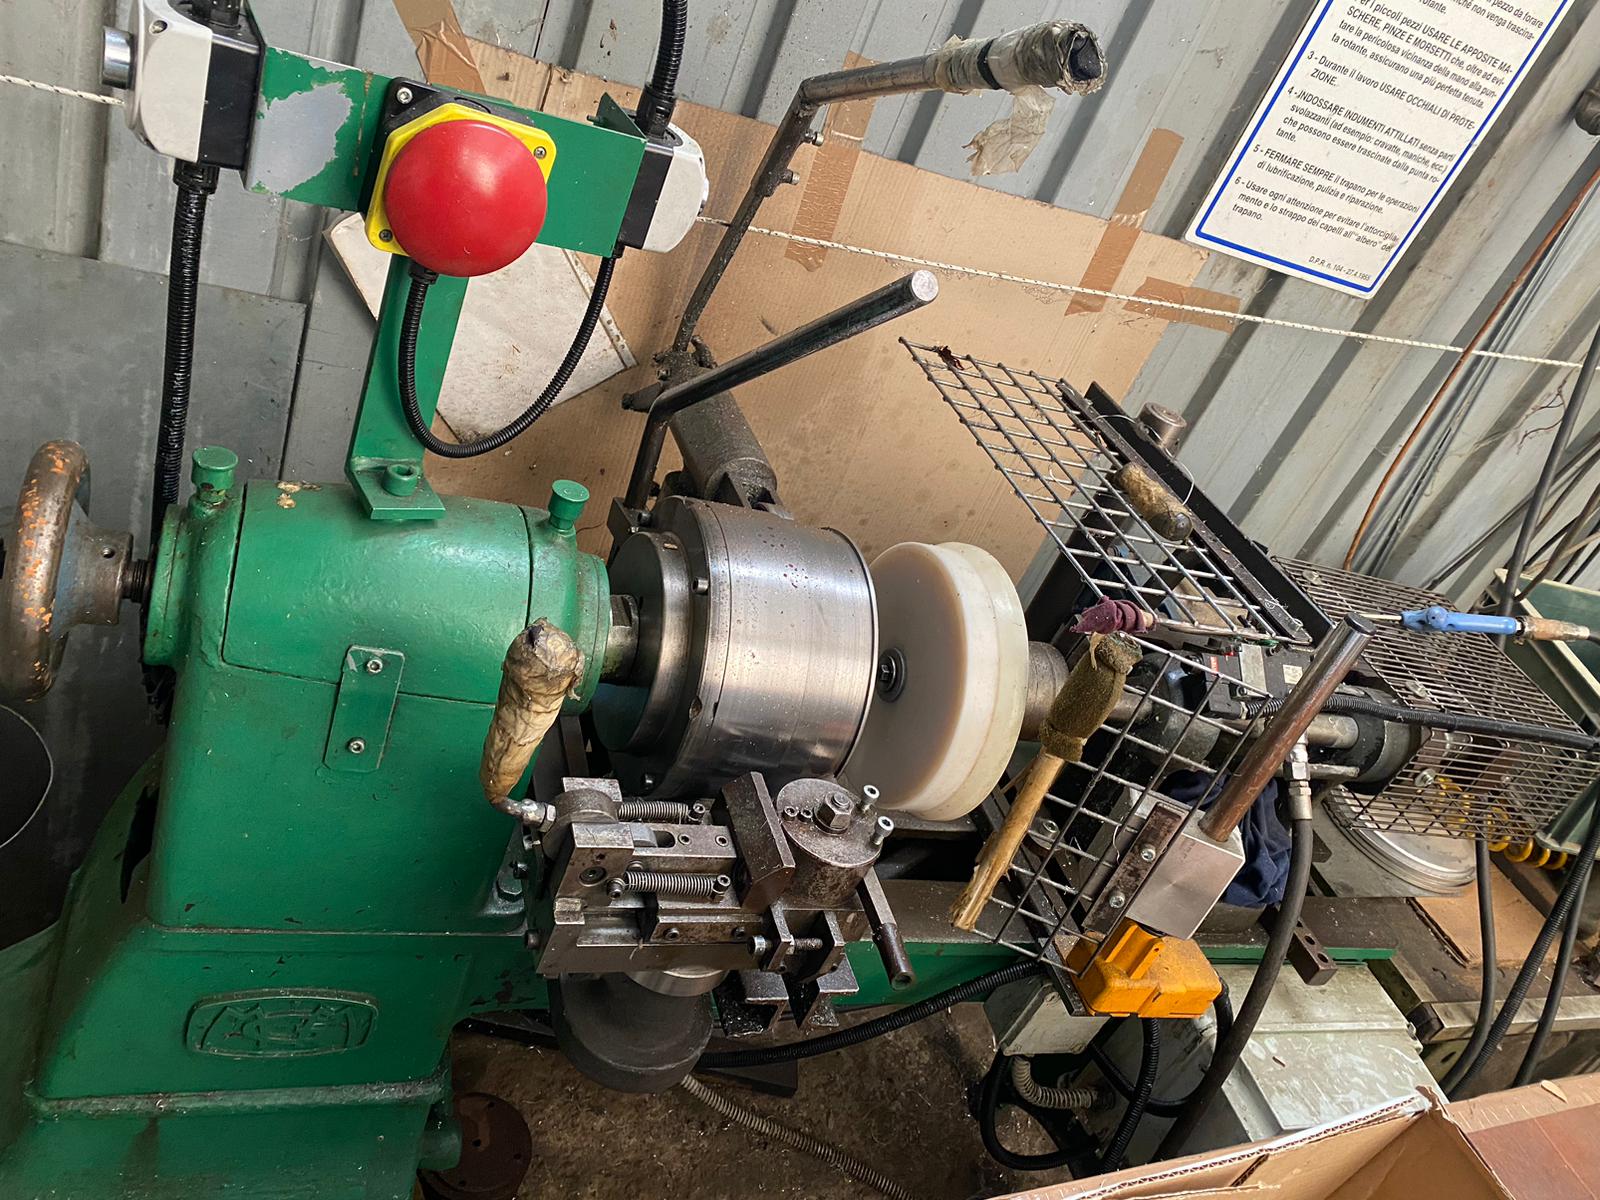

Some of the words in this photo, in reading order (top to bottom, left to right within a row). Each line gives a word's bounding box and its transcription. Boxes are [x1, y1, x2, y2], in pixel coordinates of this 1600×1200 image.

[1419, 0, 1446, 14] otante.
[1471, 4, 1486, 16] non
[1486, 11, 1507, 27] venga
[1506, 20, 1534, 40] trascina-
[1491, 0, 1514, 13] pezzo
[1513, 8, 1523, 18] da
[1522, 12, 1543, 28] forare
[1331, 33, 1340, 43] ta
[1340, 38, 1367, 57] rotante,
[1369, 52, 1409, 74] assicurano
[1409, 70, 1424, 81] una
[1421, 76, 1436, 86] più
[1434, 82, 1463, 98] perfetta
[1339, 19, 1355, 33] tare
[1354, 26, 1363, 37] la
[1361, 32, 1401, 54] pericolosa
[1400, 49, 1433, 69] vicinanza
[1433, 64, 1450, 77] della
[1449, 73, 1470, 86] mano
[1468, 81, 1482, 92] alla
[1479, 87, 1497, 98] pun-
[1347, 6, 1382, 30] SCHERE,
[1382, 23, 1407, 40] PINZE
[1405, 34, 1414, 43] E
[1412, 37, 1452, 61] MORSETTI
[1450, 56, 1464, 70] che,
[1466, 64, 1483, 76] oltre
[1481, 72, 1494, 81] ad
[1491, 76, 1504, 86] evi-
[1372, 4, 1403, 21] piccoli
[1399, 17, 1423, 31] pezzi
[1422, 24, 1451, 44] USARE
[1449, 38, 1463, 50] LE
[1460, 44, 1500, 68] APPOSITE
[1498, 61, 1512, 74] MA-
[1307, 51, 1314, 60] 3
[1318, 55, 1349, 75] Durante
[1355, 71, 1379, 88] lavoro
[1379, 82, 1407, 100] USARE
[1406, 94, 1442, 115] OCCHIALI
[1440, 109, 1451, 119] DI
[1448, 113, 1475, 130] PROTE-
[1310, 68, 1337, 86] ZIONE.
[1276, 127, 1296, 142] tante.
[1283, 116, 1298, 127] che
[1297, 123, 1332, 141] possono
[1332, 136, 1357, 151] essere
[1356, 145, 1392, 165] trascinate
[1391, 160, 1409, 172] dalla
[1408, 167, 1429, 180] punta
[1429, 175, 1440, 183] ro-
[1288, 86, 1294, 94] 4
[1343, 109, 1386, 133] INDUMENTI
[1384, 127, 1421, 147] ATTILLATI
[1419, 143, 1439, 156] senza
[1437, 151, 1456, 162] parti
[1290, 104, 1332, 125] svolazzanti
[1329, 119, 1344, 131] (ad
[1373, 139, 1401, 156] cravatte,
[1401, 150, 1430, 168] maniche,
[1235, 176, 1242, 184] 6
[1246, 180, 1268, 195] Usare
[1268, 191, 1288, 201] ogni
[1286, 197, 1324, 215] attenzione
[1322, 211, 1337, 220] per
[1336, 215, 1361, 228] evitare
[1253, 144, 1260, 152] 5
[1264, 148, 1303, 169] FERMARE
[1302, 163, 1335, 181] SEMPRE
[1339, 178, 1366, 193] trapano
[1364, 189, 1379, 198] per
[1378, 192, 1386, 201] le
[1385, 196, 1420, 213] operazioni
[1257, 161, 1267, 169] di
[1265, 163, 1314, 190] lubrificazione,
[1315, 184, 1340, 197] pulizia
[1345, 194, 1383, 214] riparazione.
[1232, 204, 1262, 220] trapano.
[1238, 193, 1263, 207] mento
[1269, 203, 1278, 212] lo
[1278, 208, 1307, 222] strappo
[1307, 217, 1320, 227] dei
[1319, 223, 1344, 235] capelli
[1381, 243, 1395, 252] del
